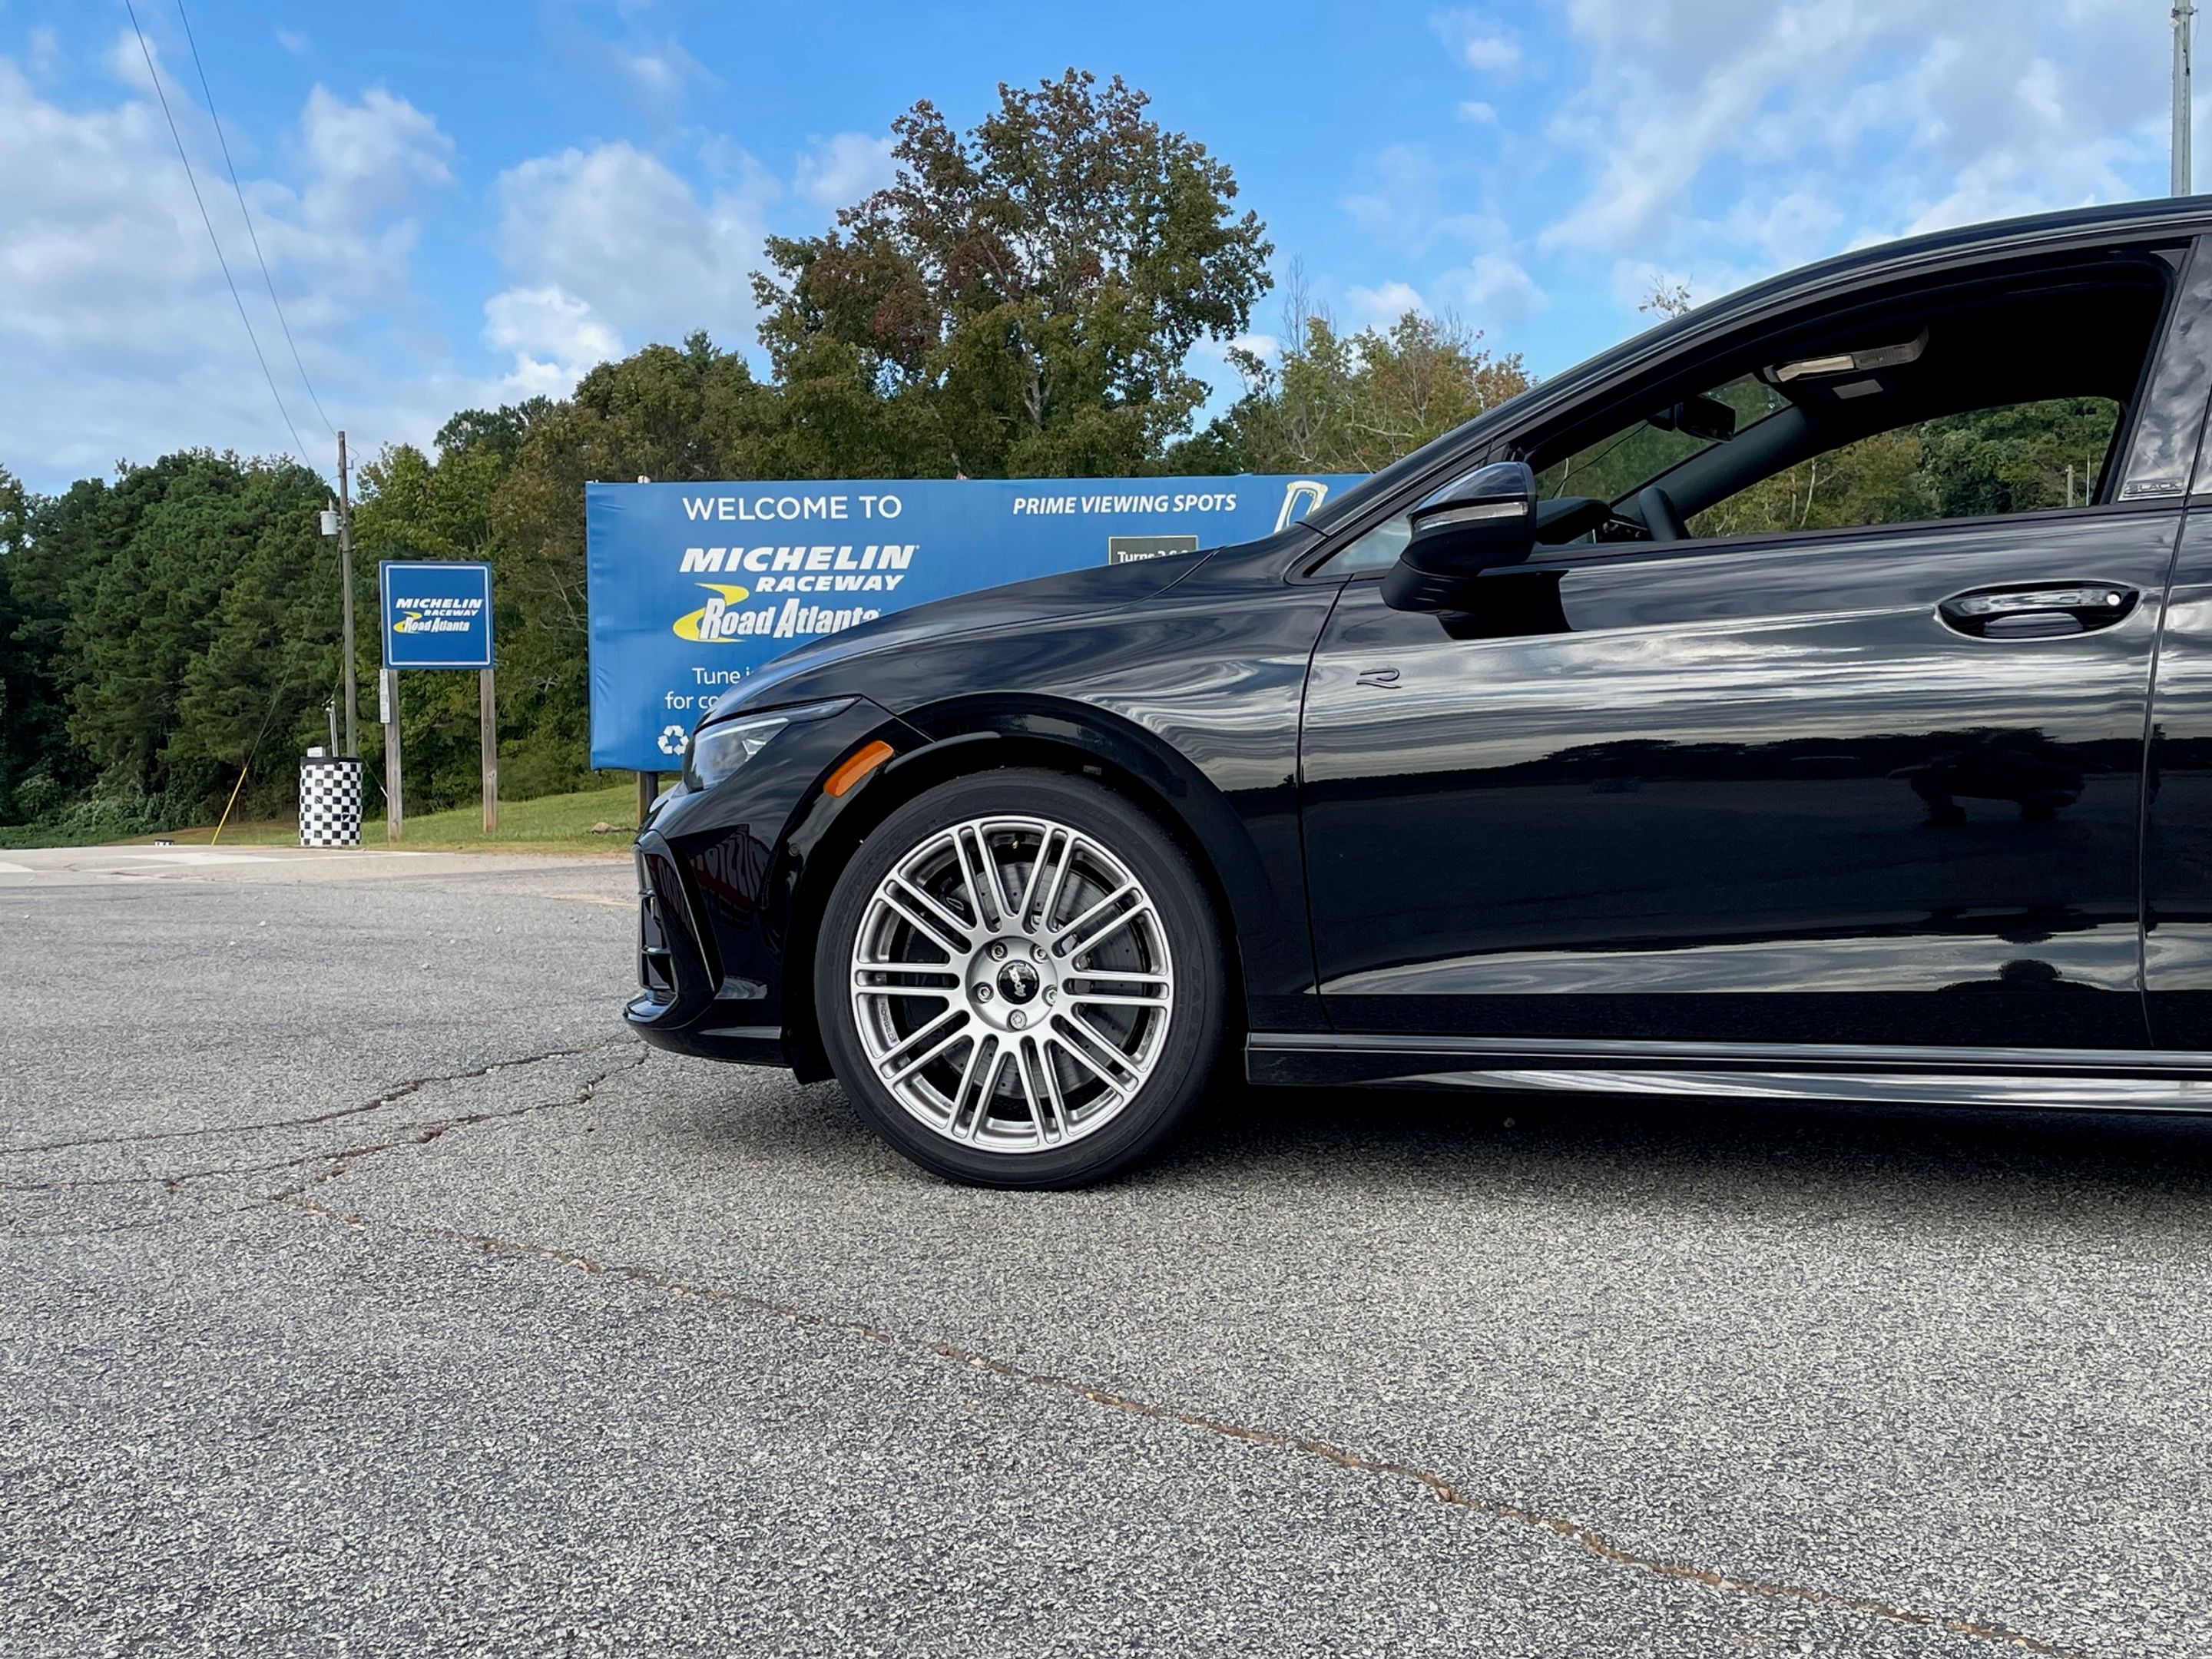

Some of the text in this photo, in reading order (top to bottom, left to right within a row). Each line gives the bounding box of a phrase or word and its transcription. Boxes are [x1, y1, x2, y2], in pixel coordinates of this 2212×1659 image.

[682, 495, 902, 521] WELCOME TO
[1012, 494, 1237, 515] PRIME VIEWING SPOTS
[679, 545, 916, 573] MICHELIN
[755, 575, 905, 593] RACEWAY
[396, 598, 483, 609] MICHELIN
[404, 617, 470, 633] Road Atlanta
[700, 598, 777, 640] Road
[691, 667, 741, 685] Tune
[664, 690, 694, 710] for
